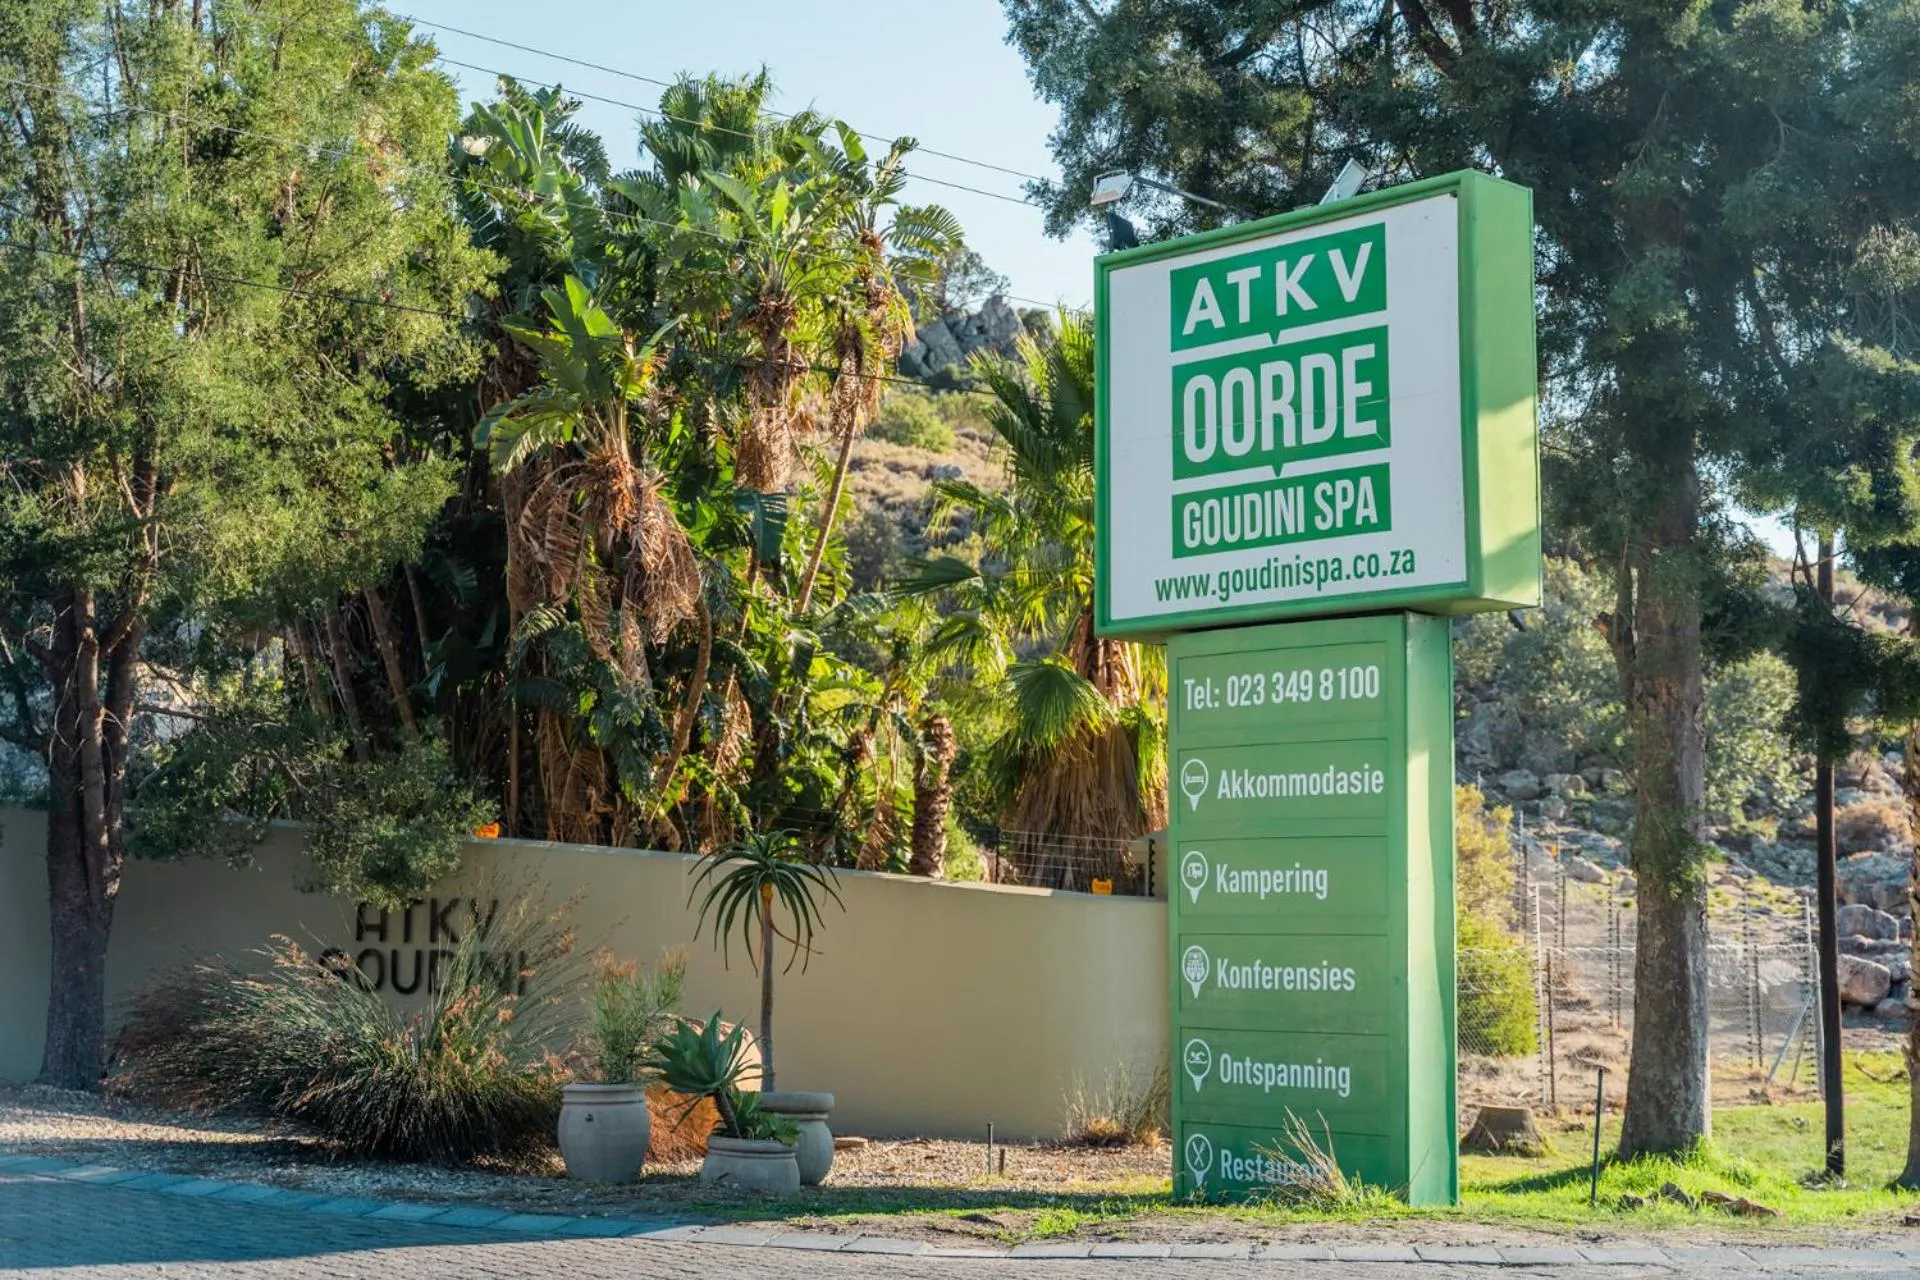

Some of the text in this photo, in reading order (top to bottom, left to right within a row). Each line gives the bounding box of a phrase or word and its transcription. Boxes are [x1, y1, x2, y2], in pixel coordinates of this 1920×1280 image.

[1182, 241, 1373, 336] ATKV
[1182, 343, 1377, 463] OORDE
[1183, 476, 1378, 549] GOUDINI SPA
[1154, 548, 1415, 602] www.goudinispa.co.za
[1184, 665, 1380, 710] Tel: 023 349 8100
[1217, 764, 1385, 799] Akkommodasie
[1216, 862, 1329, 900] Kampering
[355, 897, 500, 943] ATKV
[1216, 958, 1356, 992] Konferensies
[1219, 1053, 1351, 1098] Ontspanning
